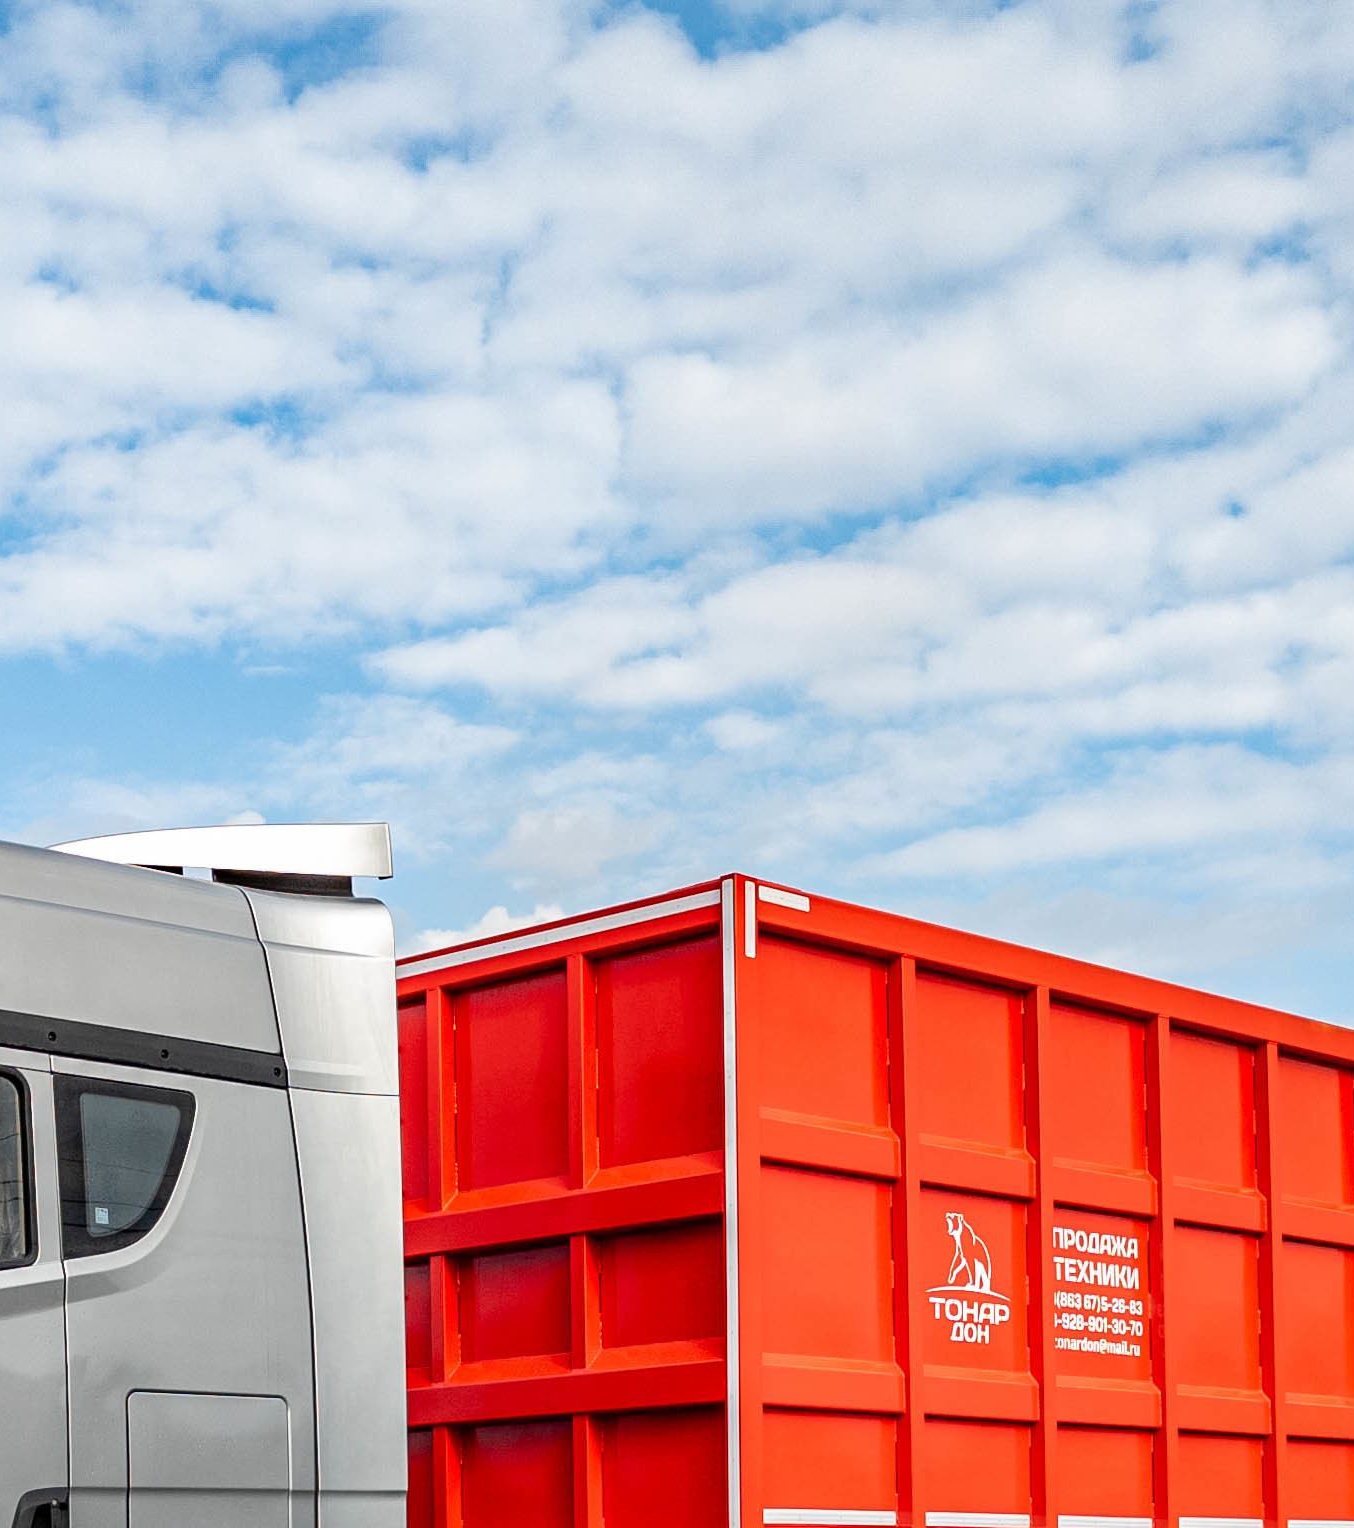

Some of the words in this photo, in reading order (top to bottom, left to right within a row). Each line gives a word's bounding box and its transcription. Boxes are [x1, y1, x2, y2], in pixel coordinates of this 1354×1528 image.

[1052, 1226, 1139, 1260] ПРОДАЖА
[1052, 1256, 1140, 1290] ТЕХНИКИ
[928, 1296, 1010, 1325] ТОНАР
[950, 1321, 990, 1345] ДОН
